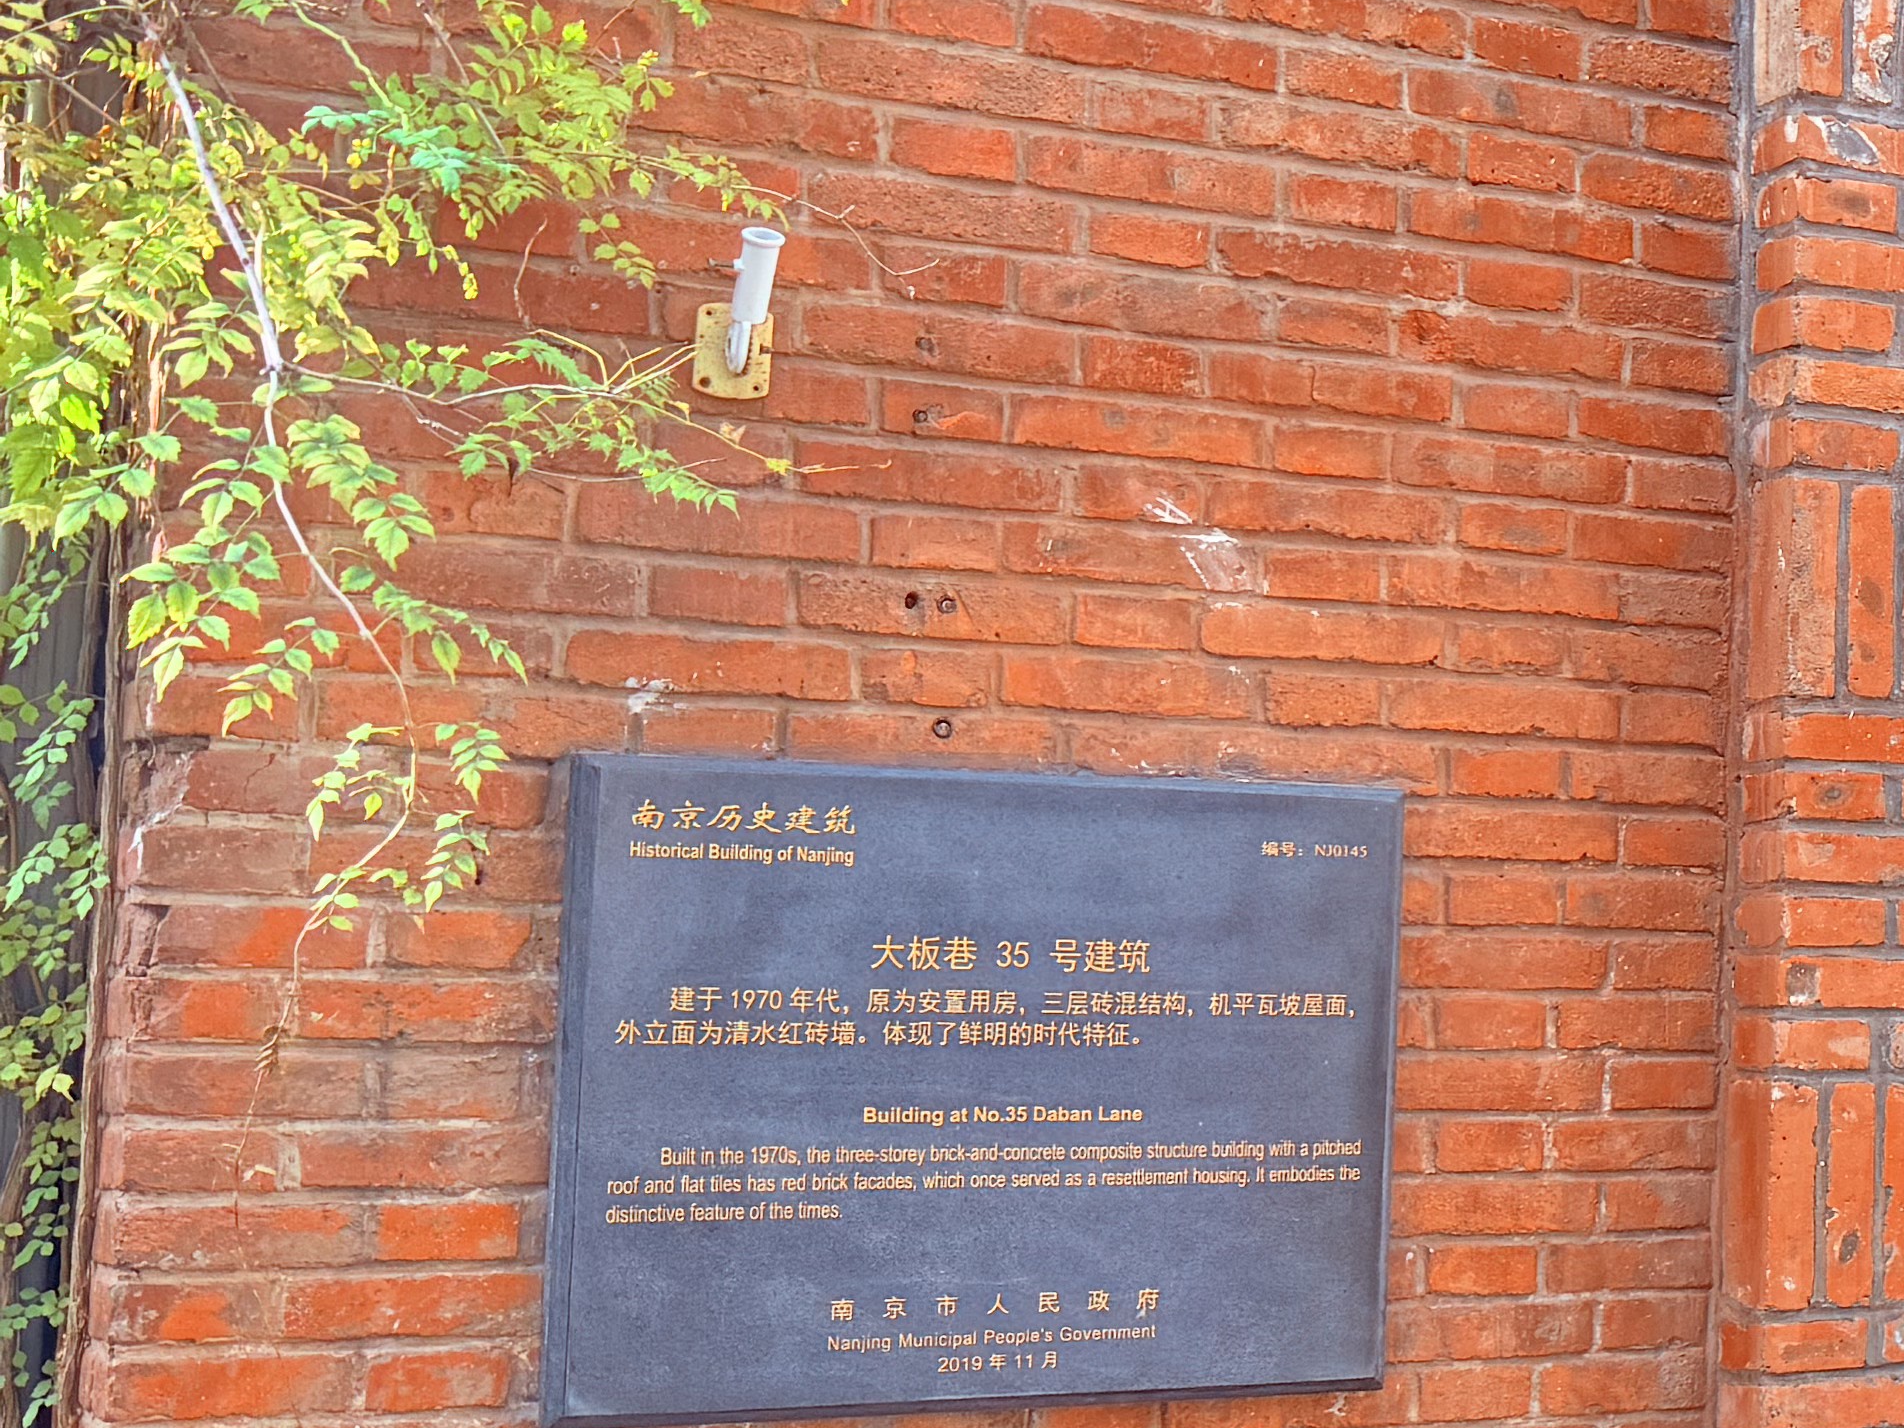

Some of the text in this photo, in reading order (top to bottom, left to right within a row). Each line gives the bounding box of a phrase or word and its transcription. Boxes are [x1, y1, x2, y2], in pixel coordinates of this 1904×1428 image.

[631, 799, 856, 835] 南京历史建筑
[630, 840, 855, 866] Historical Building of Nanjing
[1314, 844, 1368, 858] NJ0145
[871, 934, 1151, 973] 大板巷 35 号建筑
[669, 986, 723, 1013] 建于
[731, 989, 782, 1011] 1970
[863, 1106, 1143, 1127] Building at No.35 Daban Lane
[660, 1139, 1362, 1166] Built in the 1970s, the three-storey brick-and-concrete composite structure building with a pitched
[607, 1164, 1361, 1195] roof and flat tiles has red brick facades, which once served as a resettlement housing. It embodies the
[606, 1202, 843, 1223] distinctive feature of the times.
[830, 1288, 1160, 1322] 南京市人民政府
[827, 1324, 1157, 1354] Nanjing Municipal People's Government
[938, 1356, 983, 1373] 2019
